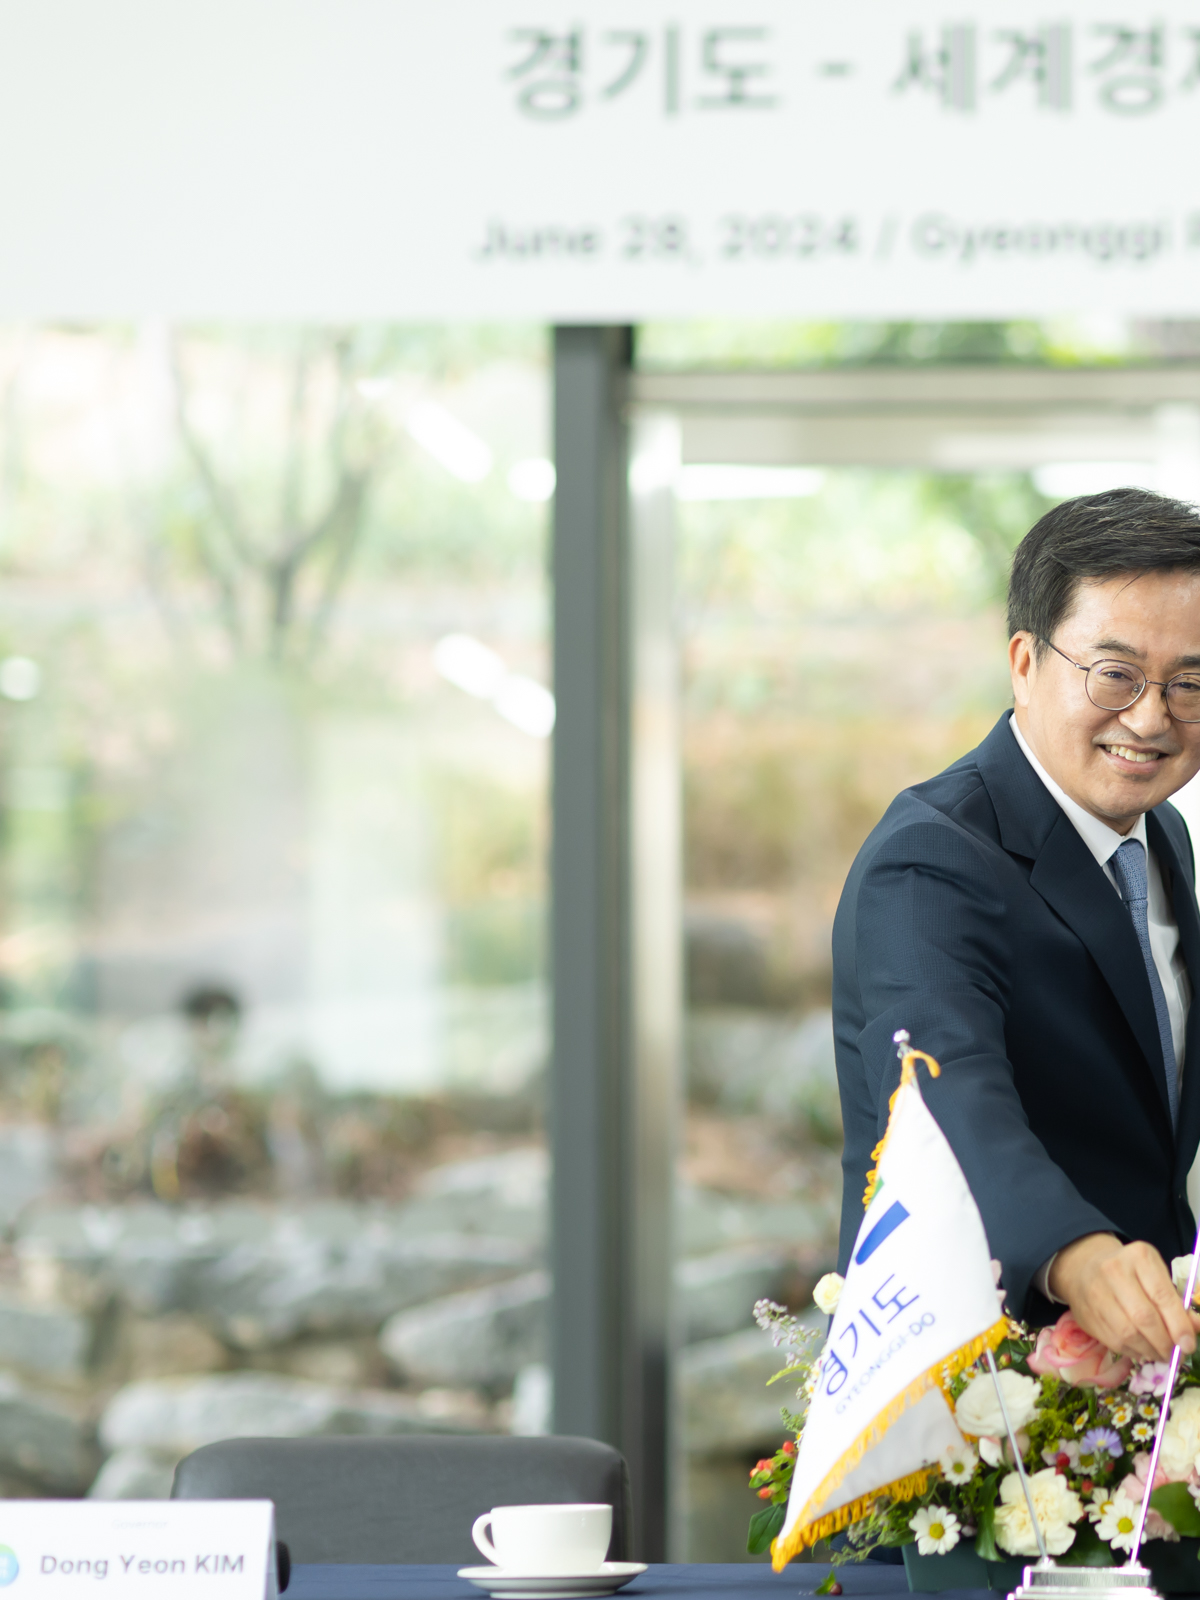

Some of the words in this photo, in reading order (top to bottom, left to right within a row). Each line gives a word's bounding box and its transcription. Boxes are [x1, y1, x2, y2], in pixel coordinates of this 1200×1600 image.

[506, 22, 778, 121] 경기도
[817, 60, 855, 79] -
[474, 218, 603, 264] June
[719, 214, 861, 262] 2024
[910, 212, 1172, 269] Gyeonggi
[818, 1273, 920, 1396] 경기도
[835, 1312, 936, 1415] GYEONGGI-DO
[111, 1518, 169, 1531] Governor
[40, 1555, 109, 1580] Dong
[119, 1555, 186, 1575] Yeon
[195, 1555, 245, 1574] KIM
